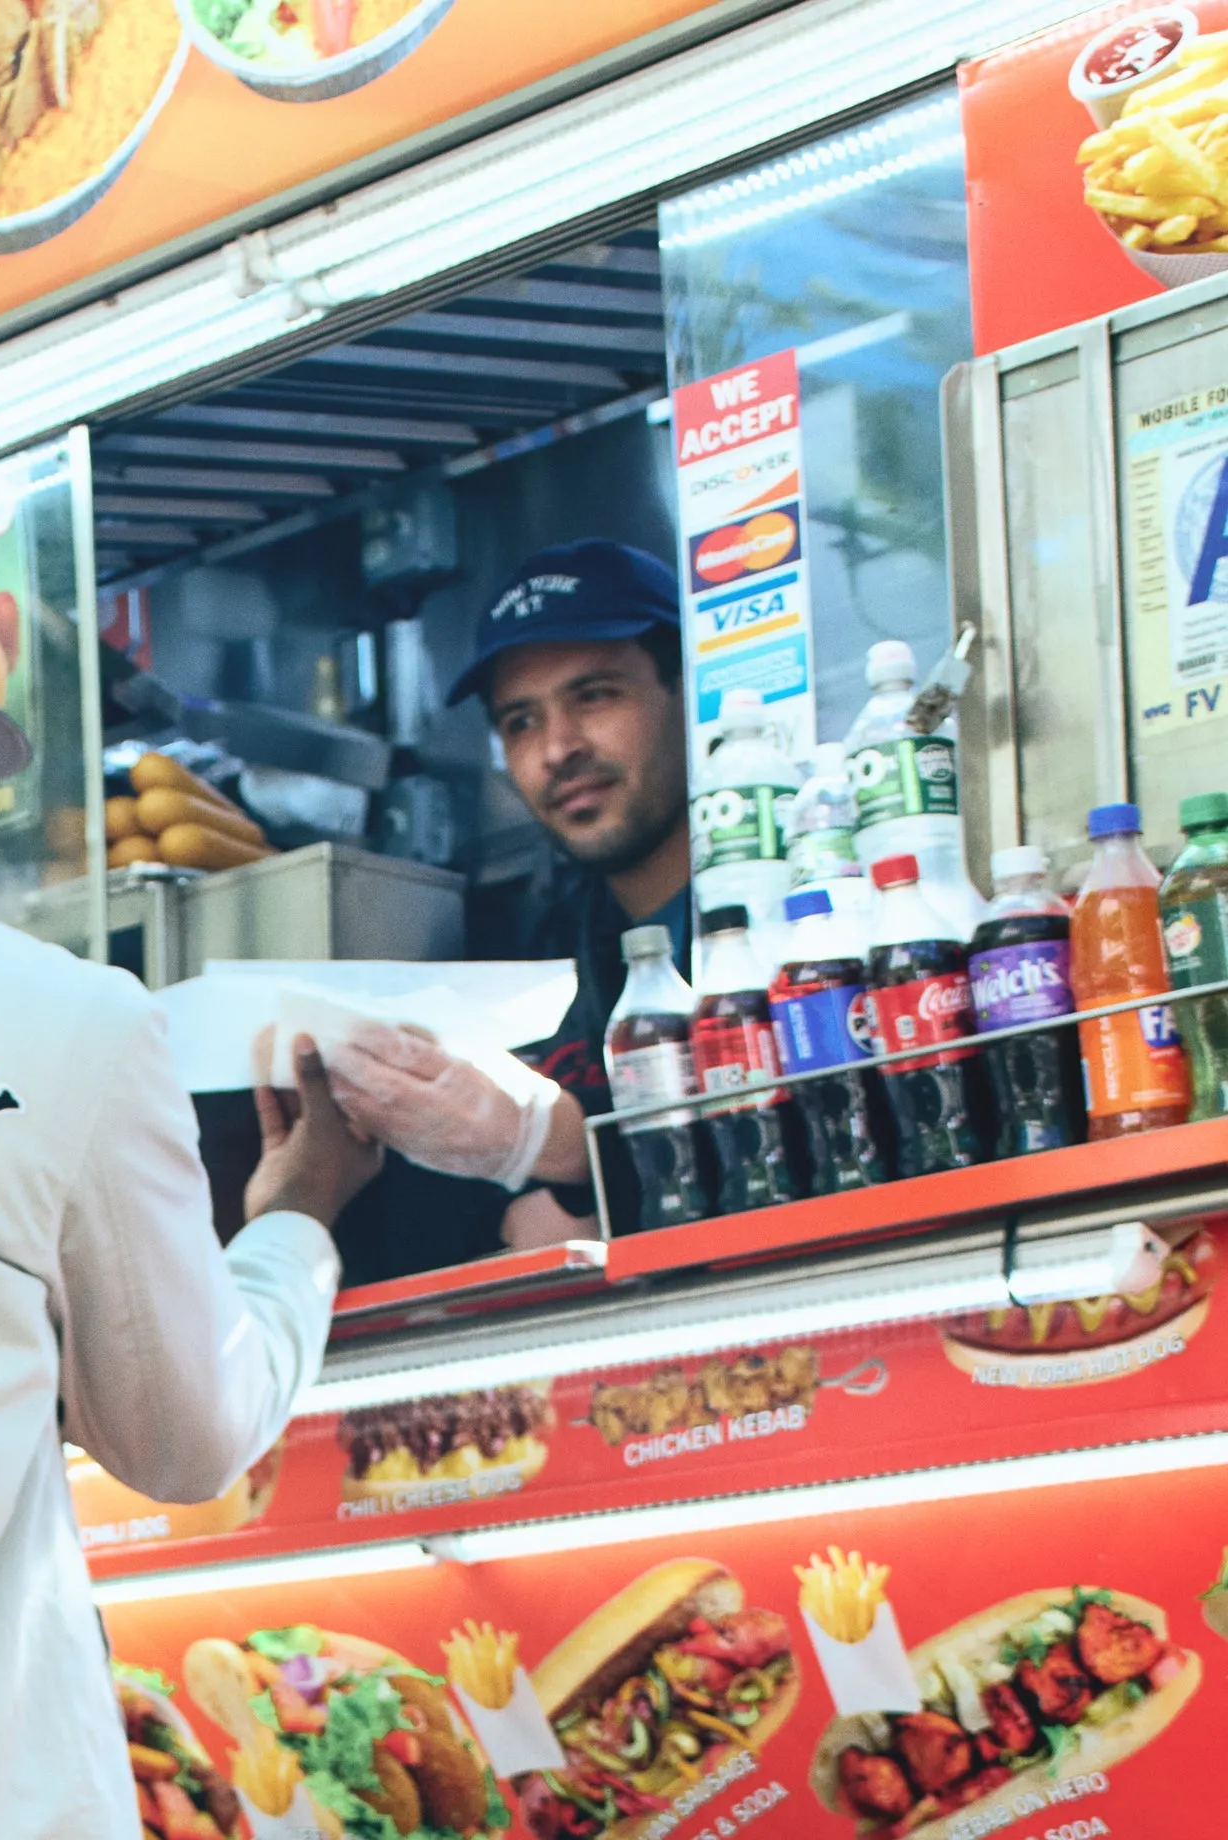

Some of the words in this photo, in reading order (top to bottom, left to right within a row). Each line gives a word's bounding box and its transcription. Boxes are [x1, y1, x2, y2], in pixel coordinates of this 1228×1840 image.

[710, 368, 762, 411] WE
[1139, 396, 1199, 428] MOBILE
[679, 393, 796, 461] ACCEPT
[690, 451, 791, 497] DISCOVER
[713, 592, 785, 632] VISA
[1185, 684, 1221, 718] FV
[972, 957, 1063, 1010] Welch's
[972, 1365, 1020, 1387] NEW
[1025, 1362, 1084, 1385] YORK
[1088, 1351, 1132, 1377] HOT
[1137, 1332, 1186, 1365] DOG
[624, 1421, 723, 1468] CHICKEN
[728, 1404, 807, 1442] KEBAB
[337, 1495, 390, 1521] CHILI
[392, 1477, 470, 1510] CHEESE
[477, 1470, 521, 1497] DOG
[673, 1750, 759, 1816] SAUSAGE
[1013, 1792, 1048, 1817] ON
[1044, 1771, 1110, 1806] HERO
[715, 1815, 738, 1839] &
[731, 1780, 790, 1824] SODA
